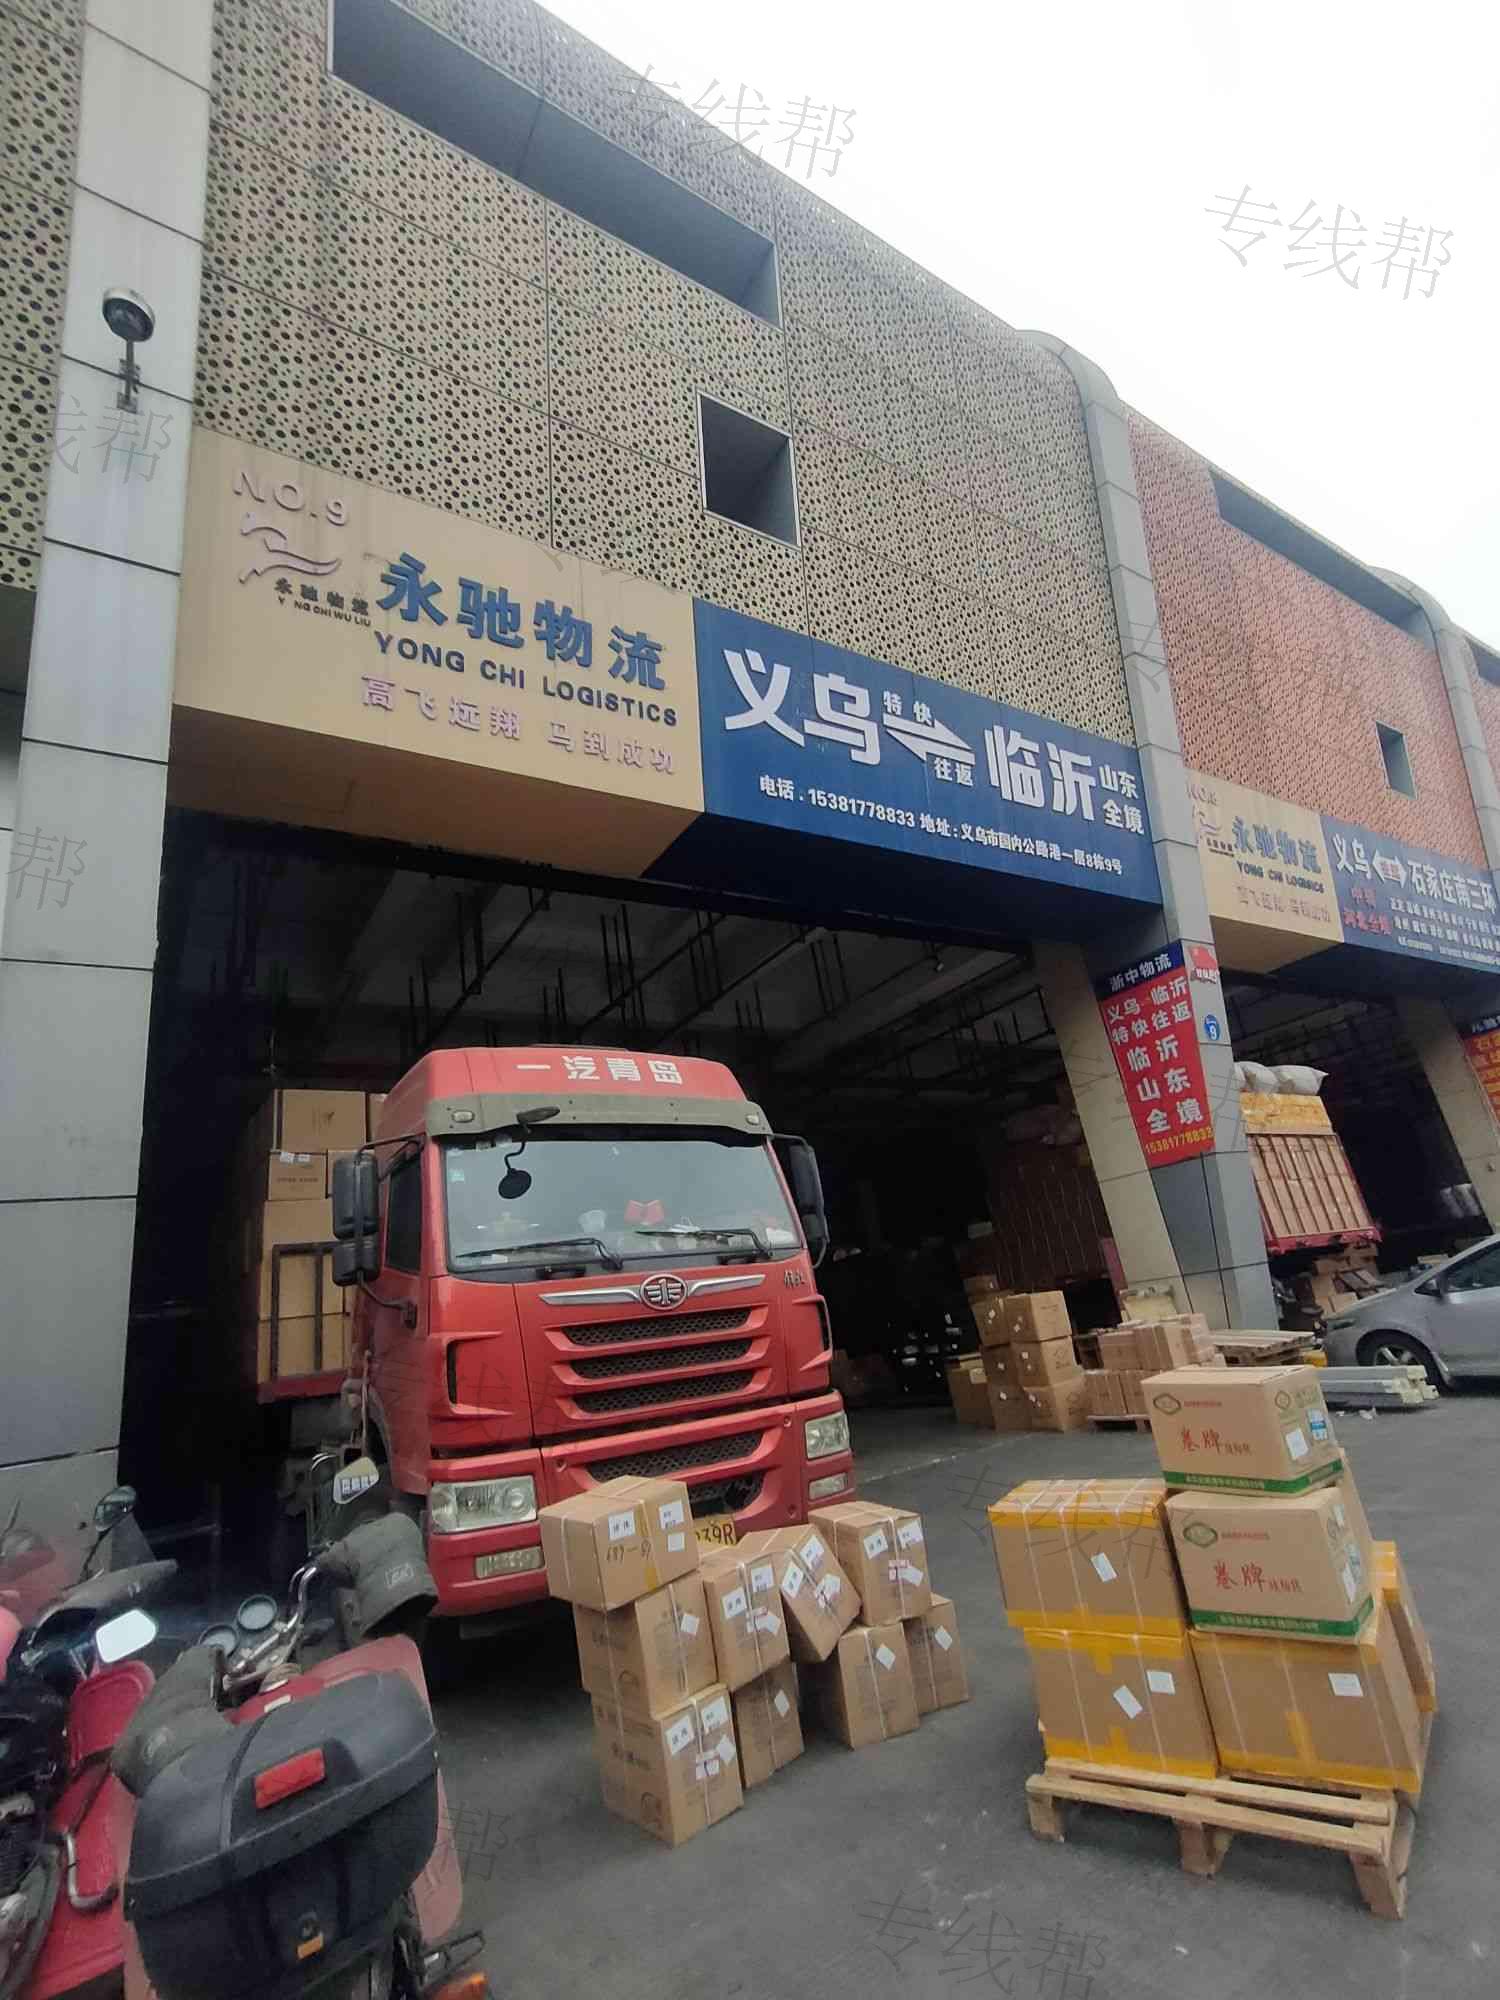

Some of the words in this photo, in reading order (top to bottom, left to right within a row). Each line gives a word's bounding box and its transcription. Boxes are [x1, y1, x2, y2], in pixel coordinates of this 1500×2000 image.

[232, 471, 348, 527] NO.9
[376, 551, 667, 690] 永驰物流
[374, 630, 465, 673] YONG
[480, 658, 525, 689] CHI
[543, 676, 677, 727] LOGISTICS
[361, 676, 520, 740] 高飞远翔
[548, 722, 675, 775] 马到成功
[882, 690, 936, 727] 特快
[723, 648, 881, 766] 义乌
[984, 725, 1096, 821] 临沂
[933, 756, 974, 788] 往返
[1099, 764, 1138, 799] 山东
[1103, 798, 1145, 836] 全境
[1333, 834, 1372, 880] 义乌
[1107, 998, 1141, 1024] 义乌
[1151, 976, 1187, 1006] 临沂
[1112, 1002, 1192, 1046] 特快往返
[516, 1055, 683, 1085] 一汽青岛
[1127, 1035, 1179, 1073] 临沂
[1137, 1067, 1191, 1102] 山东
[1147, 1098, 1203, 1134] 全境
